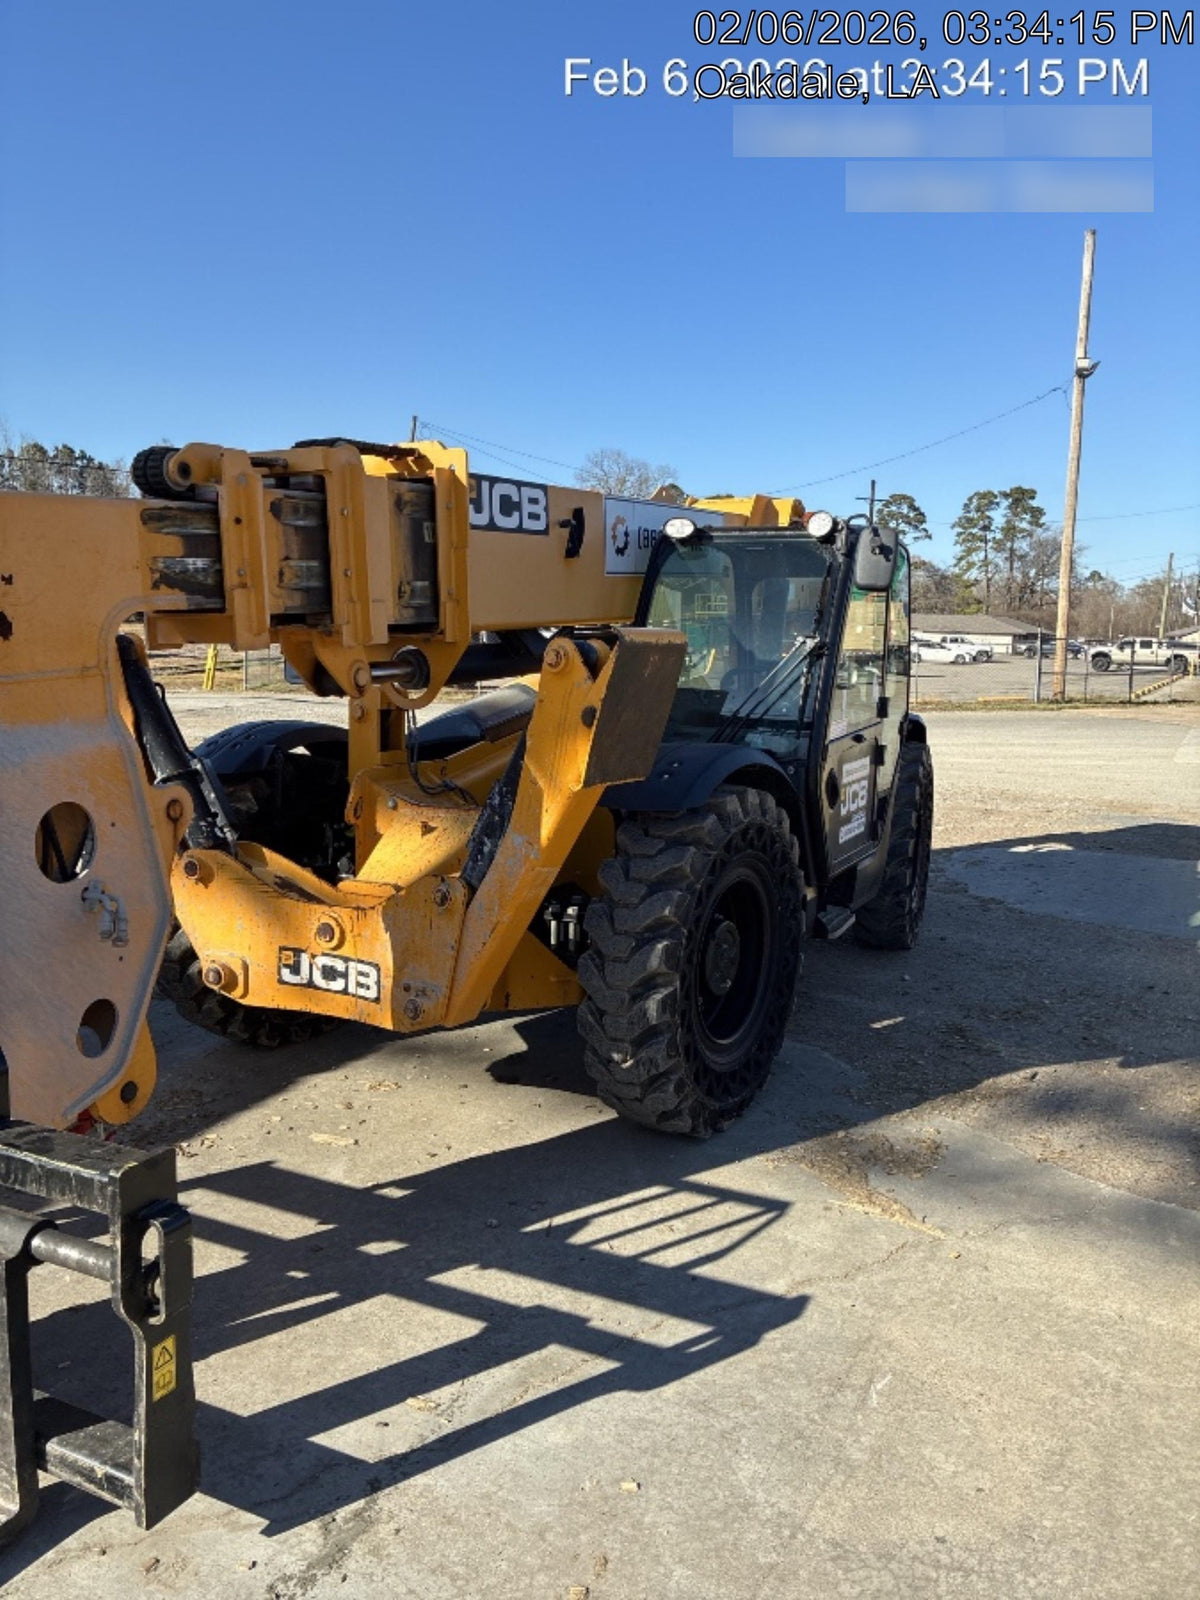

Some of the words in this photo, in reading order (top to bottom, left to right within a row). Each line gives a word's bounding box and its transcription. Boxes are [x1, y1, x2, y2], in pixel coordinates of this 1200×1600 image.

[469, 479, 548, 532] JCB
[841, 779, 868, 817] JCB
[281, 950, 379, 1000] JCB
